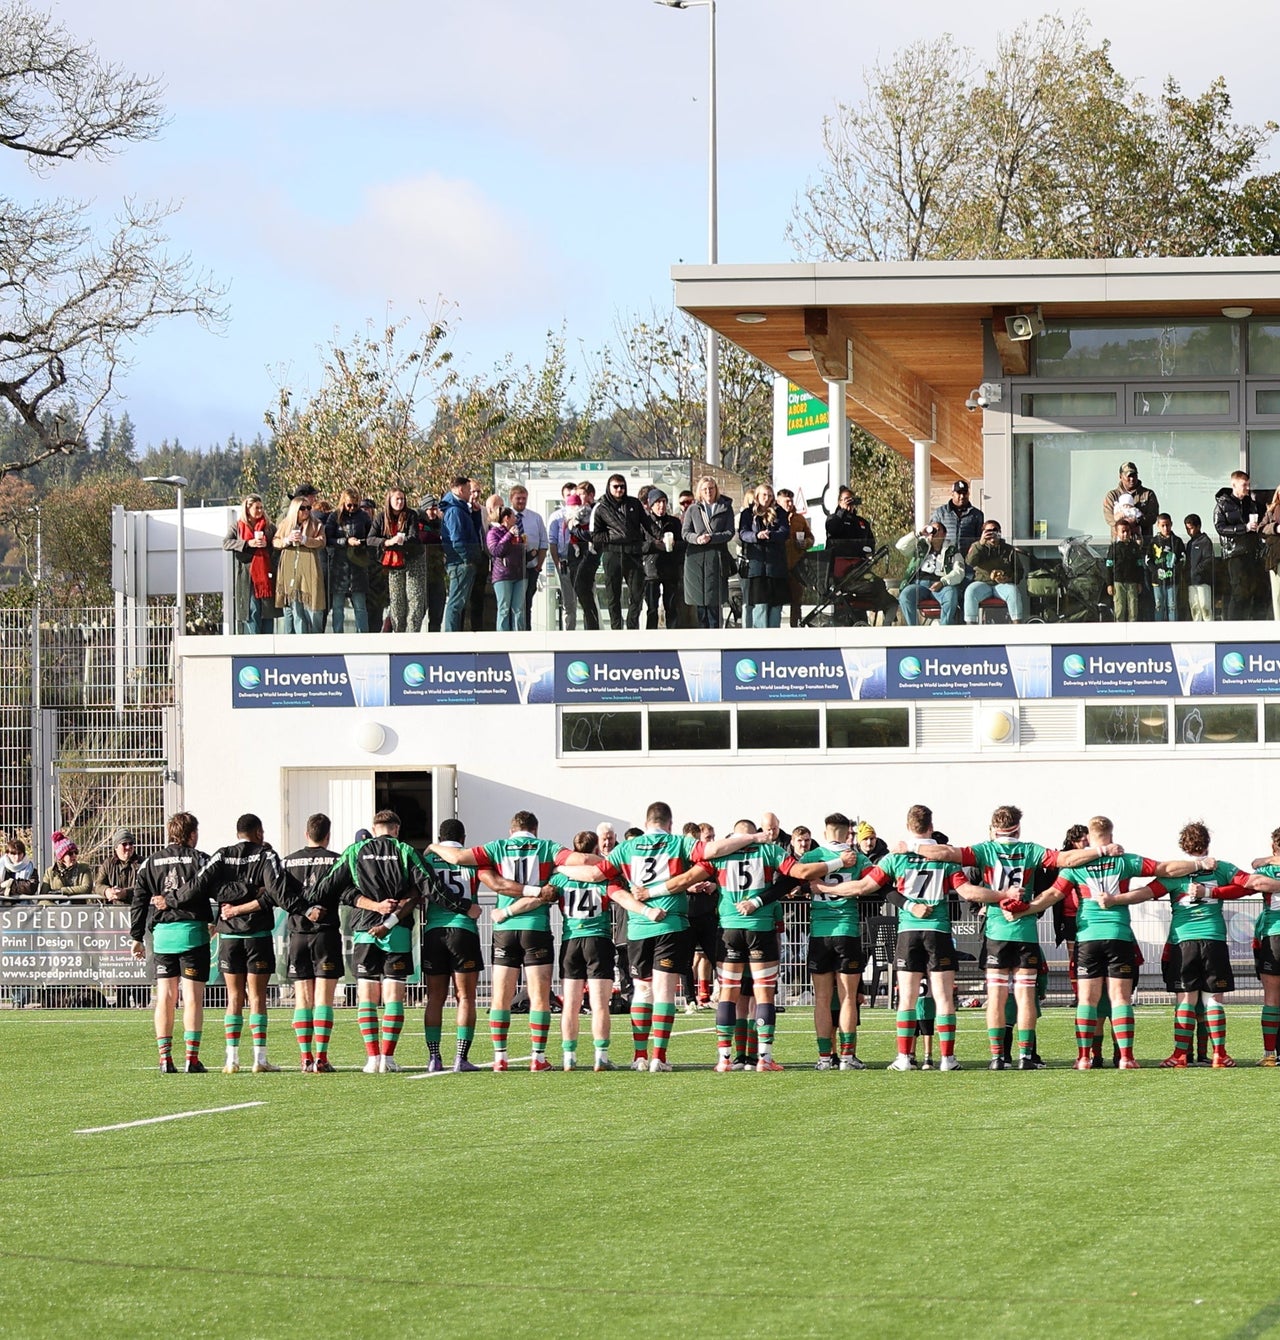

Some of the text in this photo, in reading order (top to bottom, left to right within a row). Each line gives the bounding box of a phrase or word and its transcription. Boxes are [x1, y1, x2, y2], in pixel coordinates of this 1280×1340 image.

[594, 663, 680, 680] Haventus
[762, 661, 844, 678] Haventus
[925, 659, 1008, 675] Haventus
[1090, 657, 1172, 674] Haventus
[265, 668, 348, 685] Haventus
[429, 666, 512, 683] Haventus
[514, 858, 528, 887] 11
[642, 857, 657, 884] 3
[738, 861, 751, 890] 5
[917, 871, 934, 898] 7
[569, 890, 597, 917] 14
[2, 911, 131, 928] SPEEDPRIN
[2, 937, 26, 947] Print
[37, 936, 74, 949] Design
[83, 937, 111, 949] Copy
[2, 956, 82, 967] 01463 710928
[2, 968, 146, 980] www.speedprintdigital.co.uk
